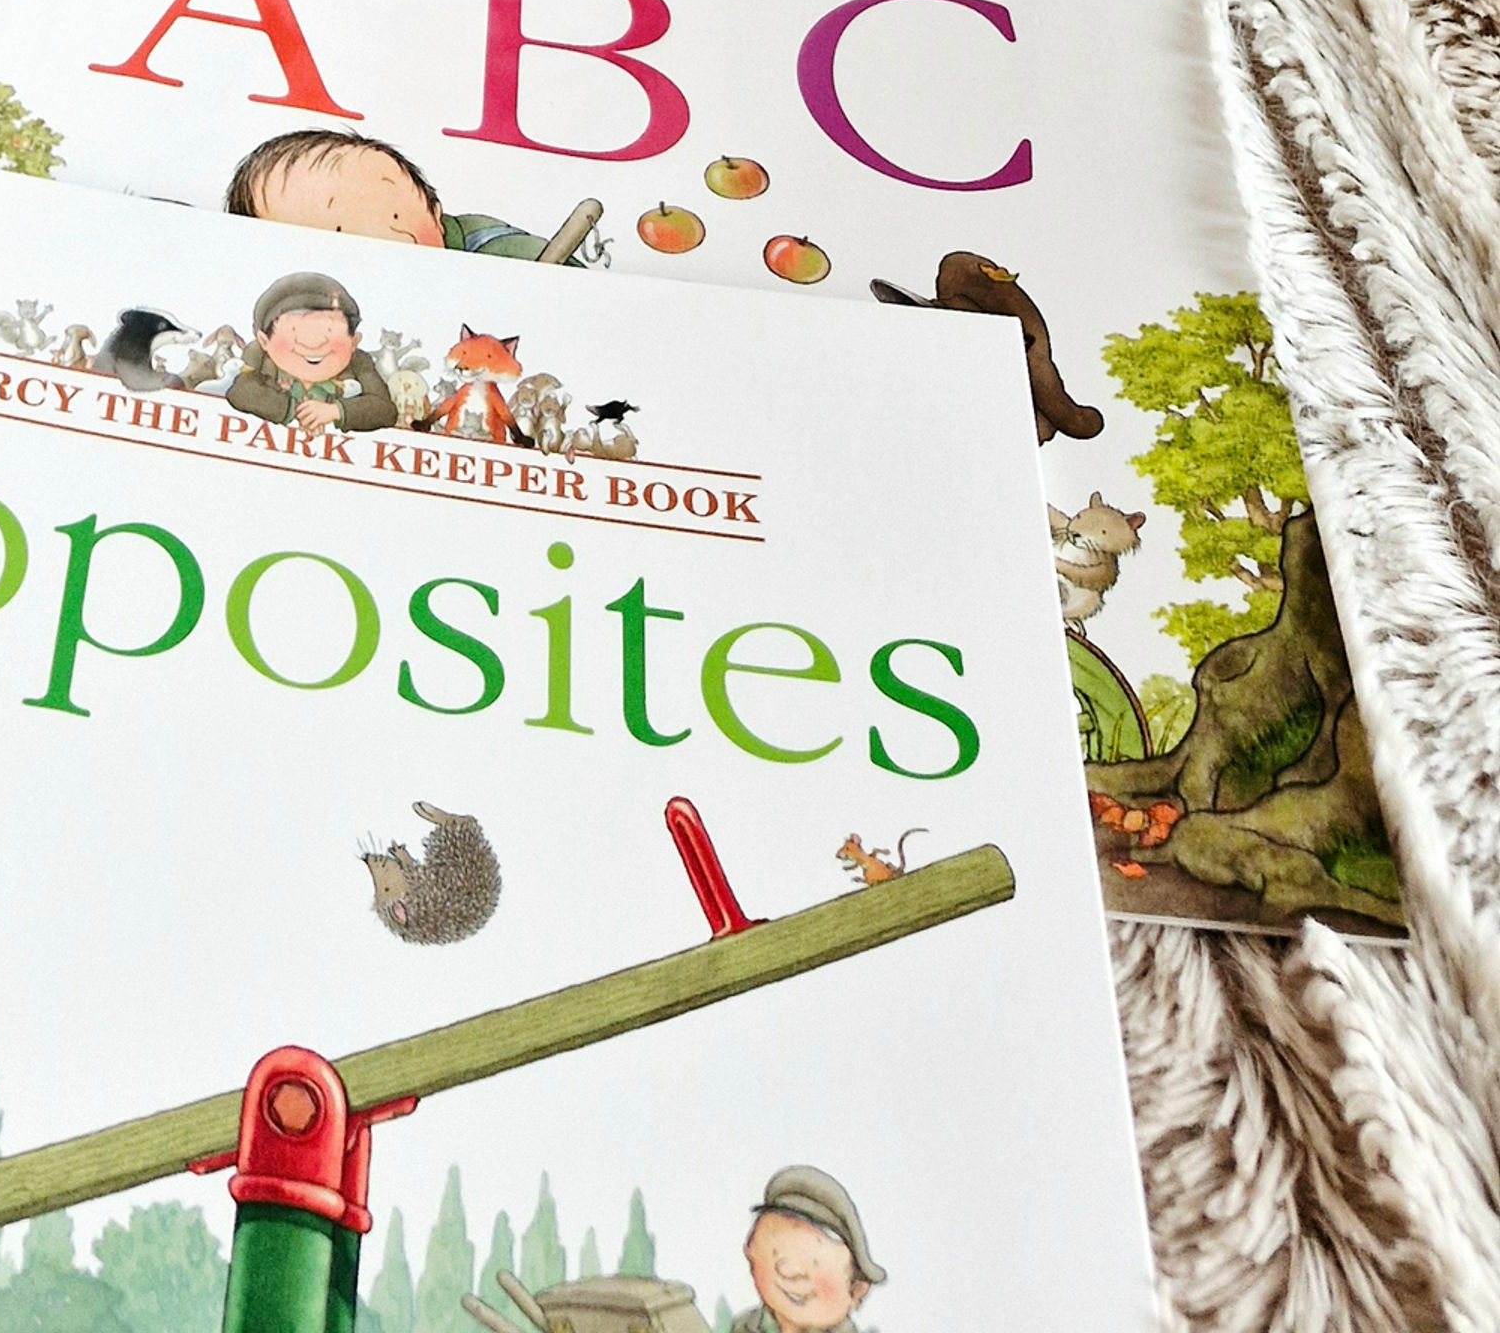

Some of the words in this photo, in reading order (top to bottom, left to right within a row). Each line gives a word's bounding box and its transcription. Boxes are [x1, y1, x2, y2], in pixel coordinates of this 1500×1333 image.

[96, 390, 203, 437] THE
[214, 413, 357, 466] PARK
[370, 441, 593, 497] KEEPER
[605, 473, 762, 523] BOOK
